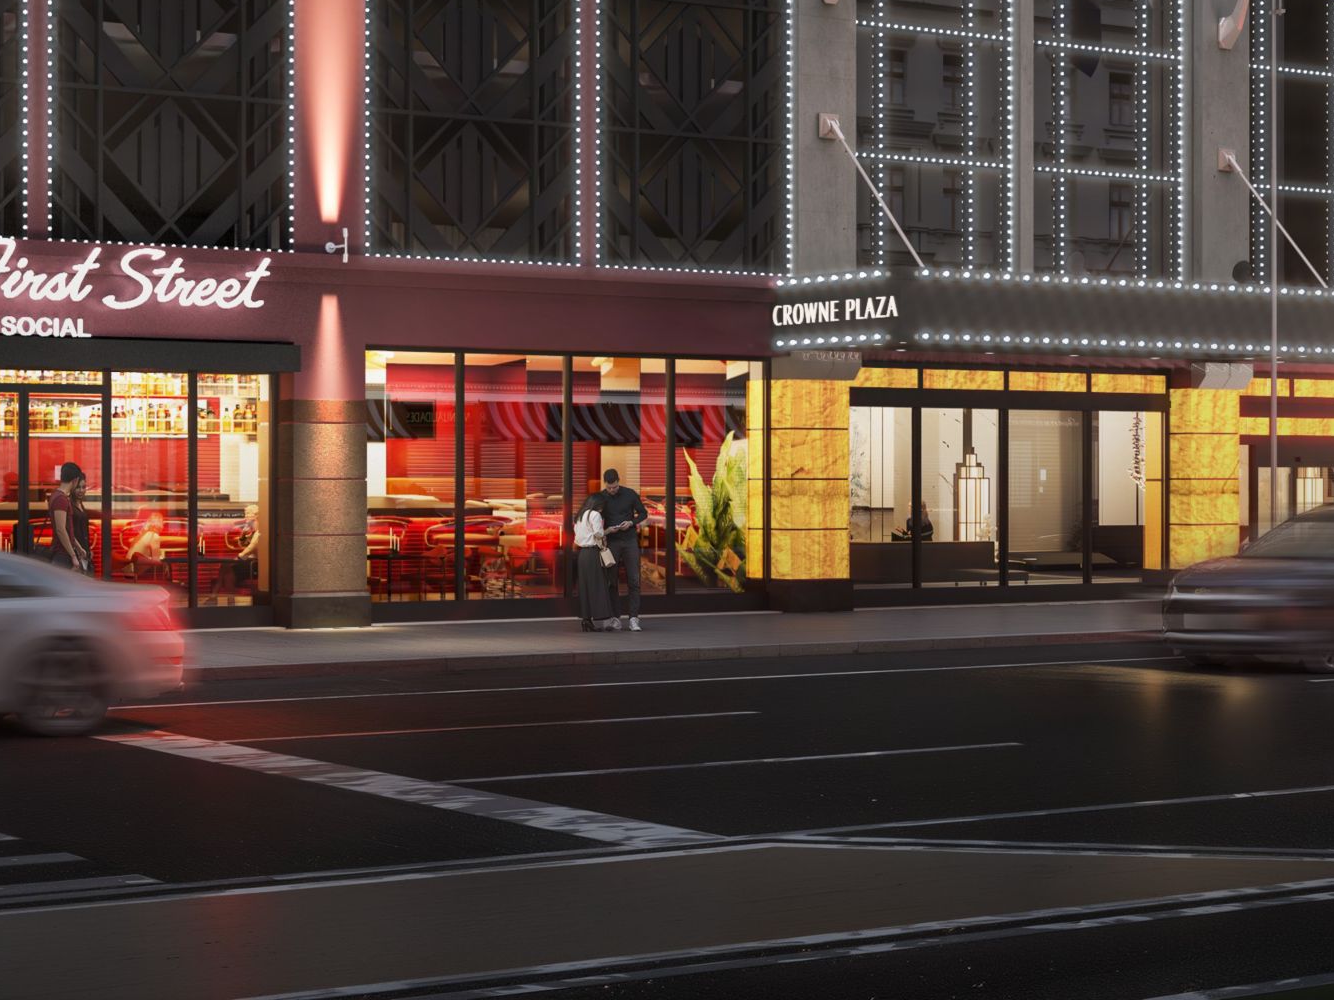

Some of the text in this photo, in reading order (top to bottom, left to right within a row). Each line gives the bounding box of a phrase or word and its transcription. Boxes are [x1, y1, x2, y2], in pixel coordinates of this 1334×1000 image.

[102, 247, 272, 310] Street
[772, 295, 899, 326] CROWNE PLAZA
[0, 315, 92, 338] SOCIAL
